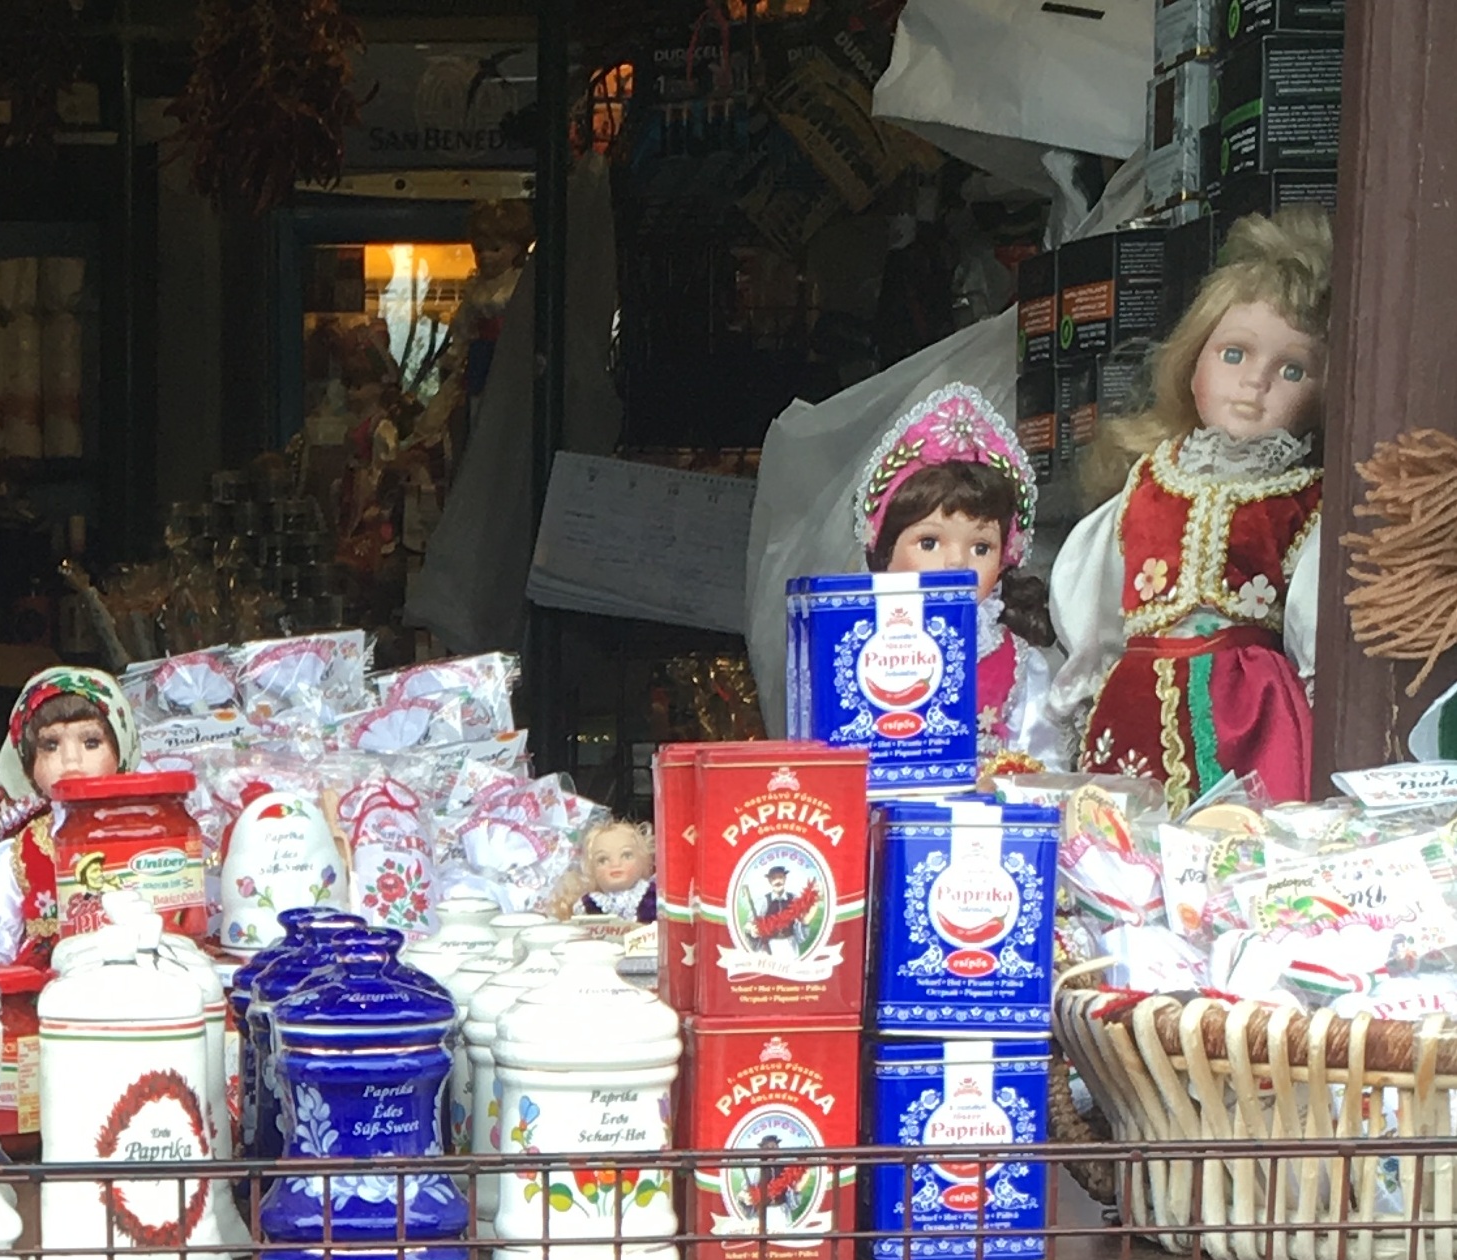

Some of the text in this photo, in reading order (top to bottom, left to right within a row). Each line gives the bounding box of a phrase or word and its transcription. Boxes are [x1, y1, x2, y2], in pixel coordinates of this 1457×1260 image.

[423, 128, 505, 151] BENED
[864, 650, 937, 669] Paprika
[721, 801, 845, 847] PAPRIKA
[135, 856, 187, 870] Univer
[936, 885, 1013, 904] Paprika
[363, 1084, 414, 1101] Paprika
[589, 1090, 639, 1104] Paprika
[714, 1071, 836, 1117] PAPRIKA
[372, 1103, 404, 1119] Édes
[577, 1129, 647, 1147] Scharf-Hot
[930, 1121, 1007, 1140] Paprika
[124, 1137, 193, 1162] Paprika
[948, 1192, 978, 1204] csípő
